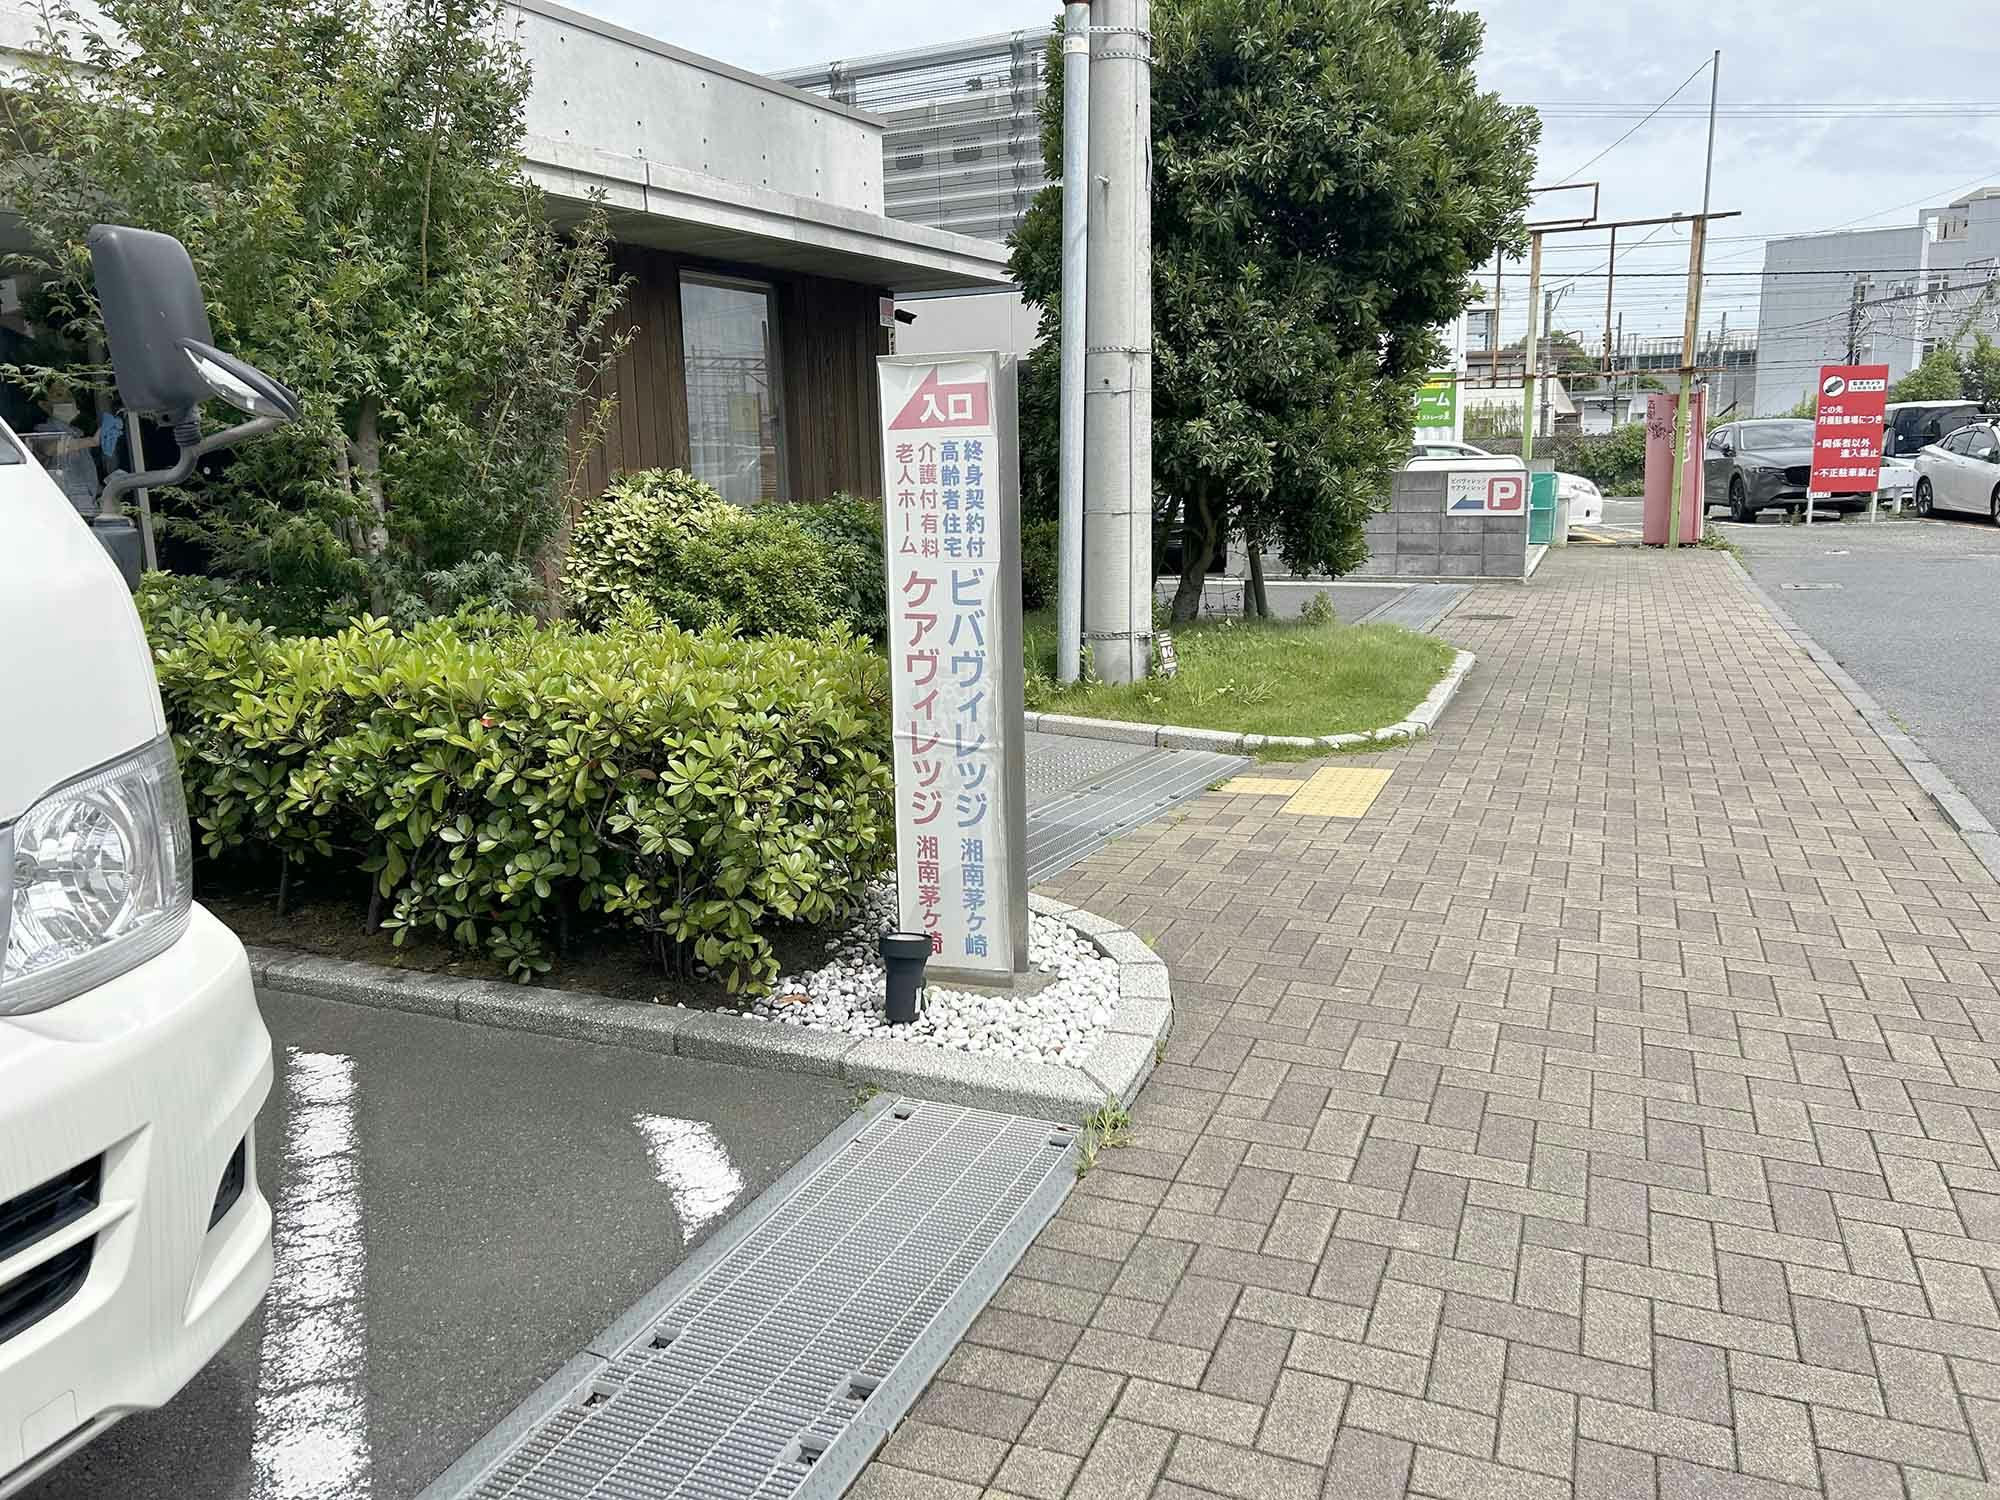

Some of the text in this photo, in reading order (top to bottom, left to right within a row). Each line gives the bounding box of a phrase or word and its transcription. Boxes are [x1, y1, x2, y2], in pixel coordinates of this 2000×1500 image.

[919, 393, 974, 422] 入口
[1820, 405, 1843, 414] この先
[896, 443, 918, 554] 老人ホーム
[918, 441, 940, 558] 介護付有料
[940, 440, 962, 558] 高齢者住宅
[963, 440, 985, 558] 終身契約付
[1492, 480, 1517, 507] P
[902, 570, 942, 826] ケアヴィレッジ
[948, 567, 988, 828] ビバヴィレッジ
